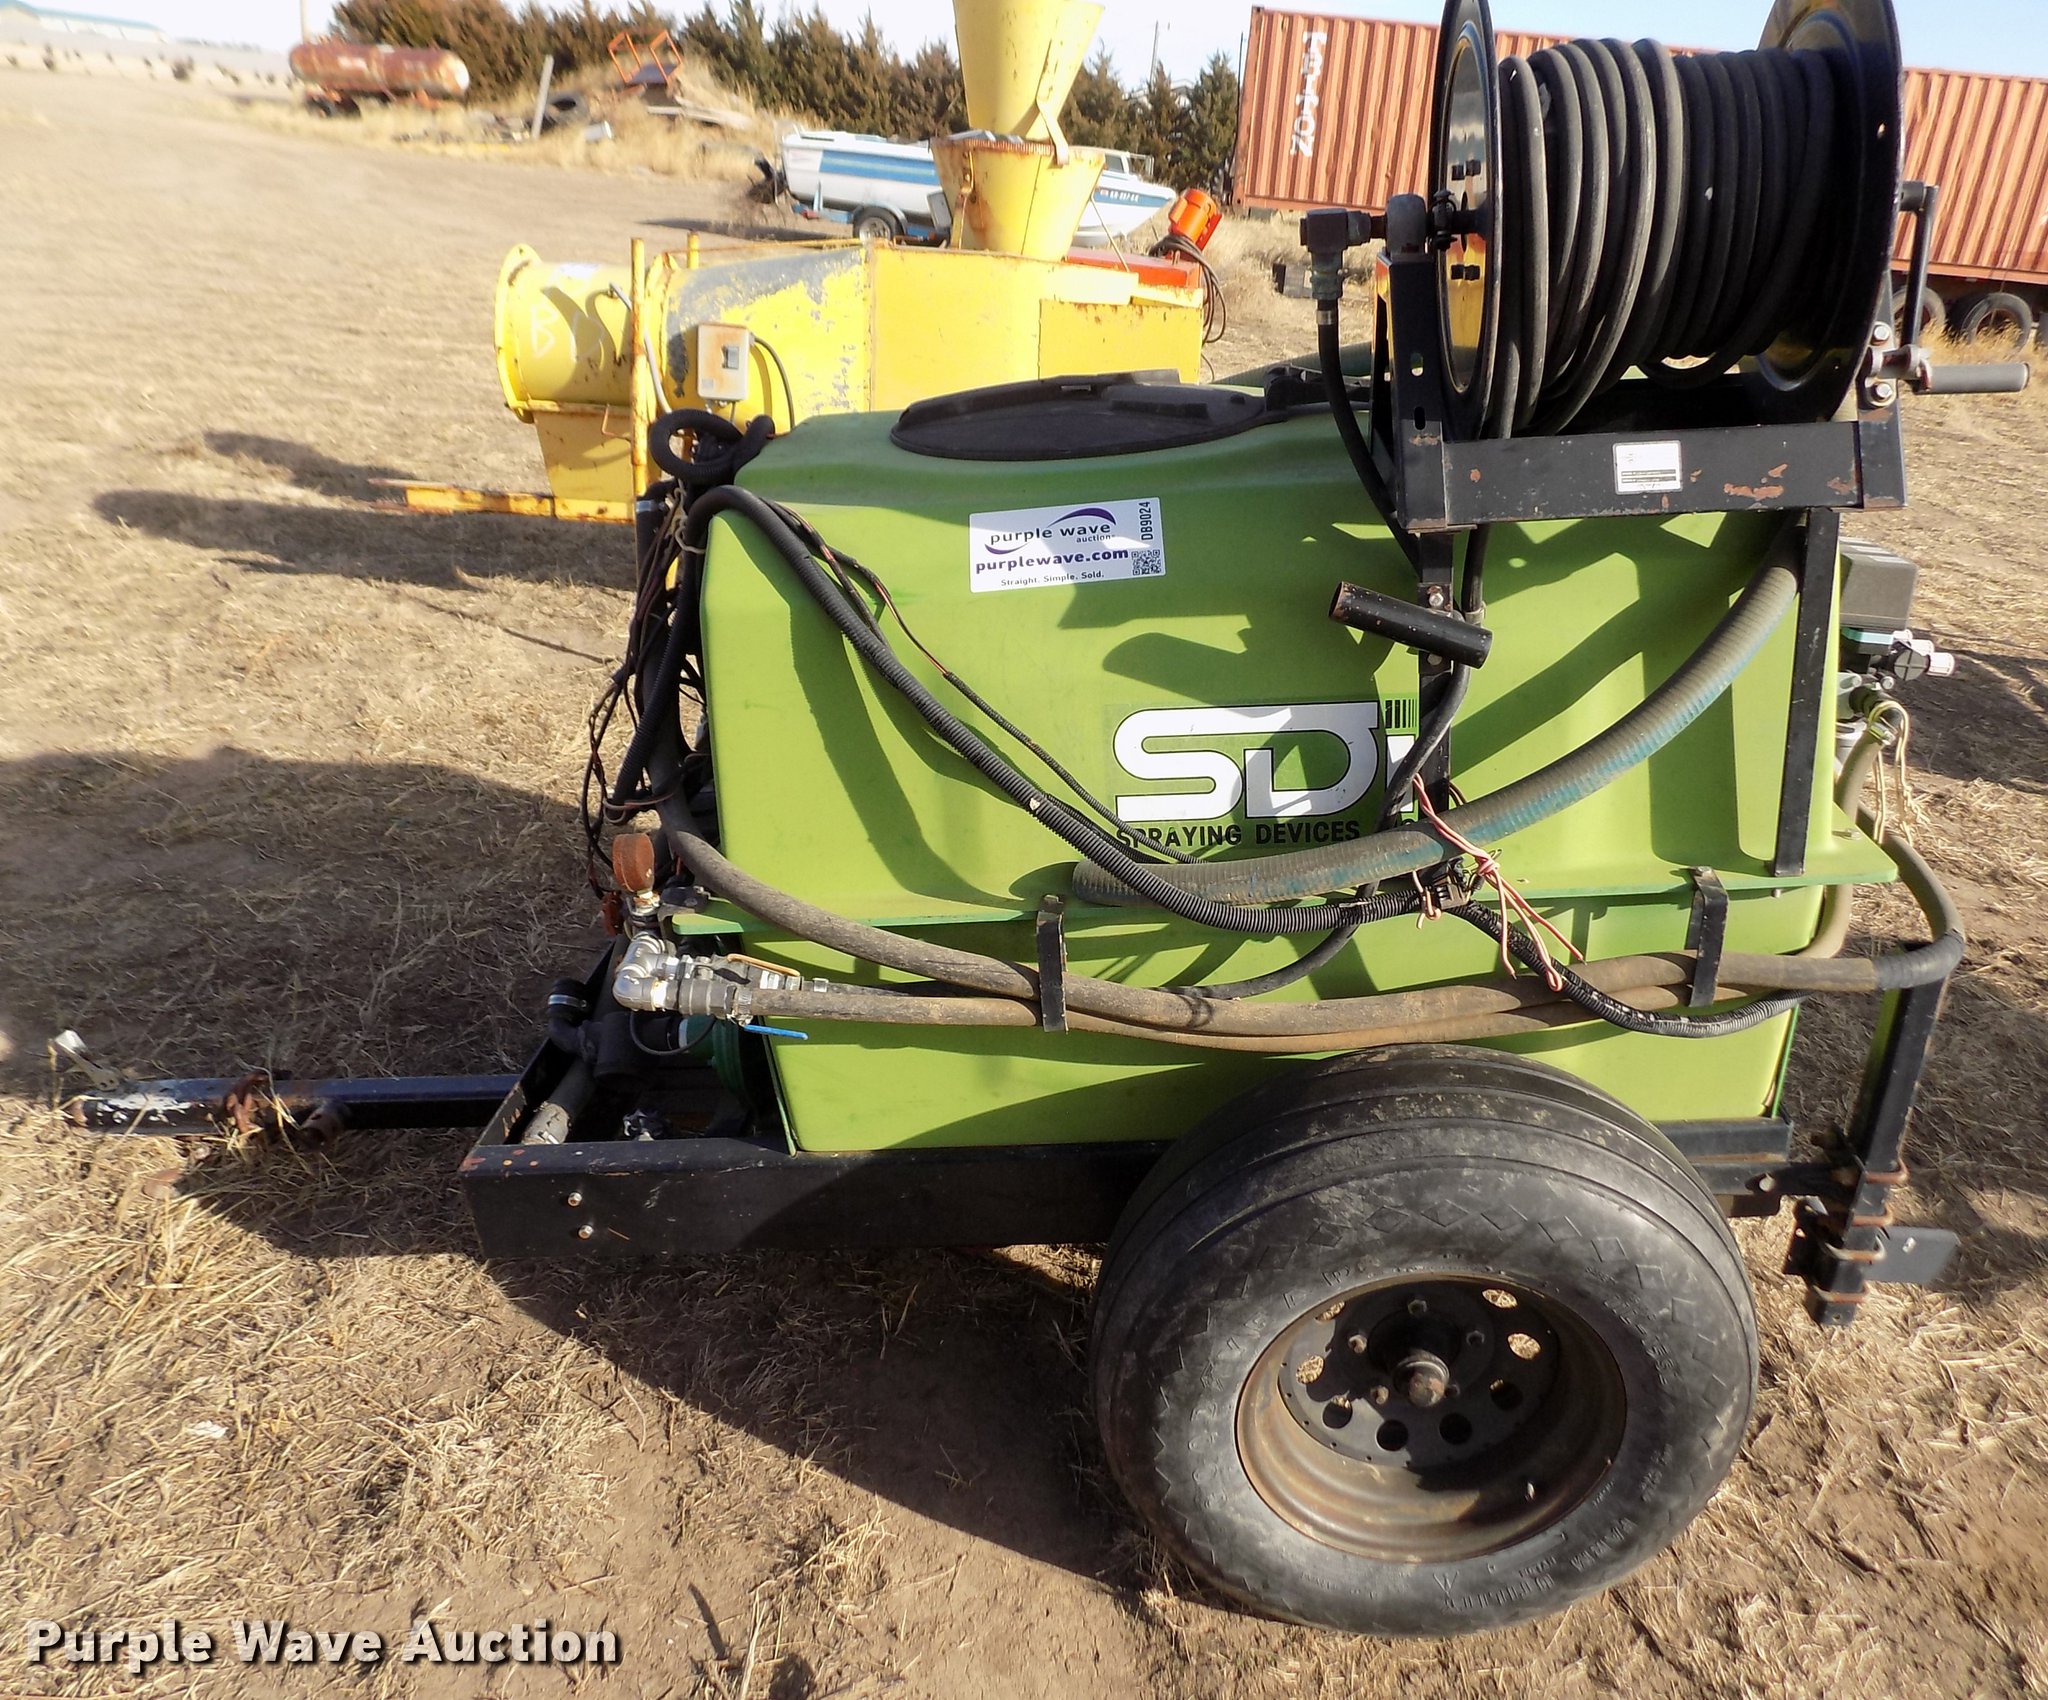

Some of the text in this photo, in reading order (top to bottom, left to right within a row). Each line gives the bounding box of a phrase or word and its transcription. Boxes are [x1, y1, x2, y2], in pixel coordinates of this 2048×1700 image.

[990, 522, 1111, 546] purple wave
[1138, 501, 1154, 541] DB9024
[975, 548, 1129, 575] purplewave.com
[1001, 570, 1105, 587] Straight. Simple. Sold.
[1115, 819, 1361, 849] SPRAYING DEVICES
